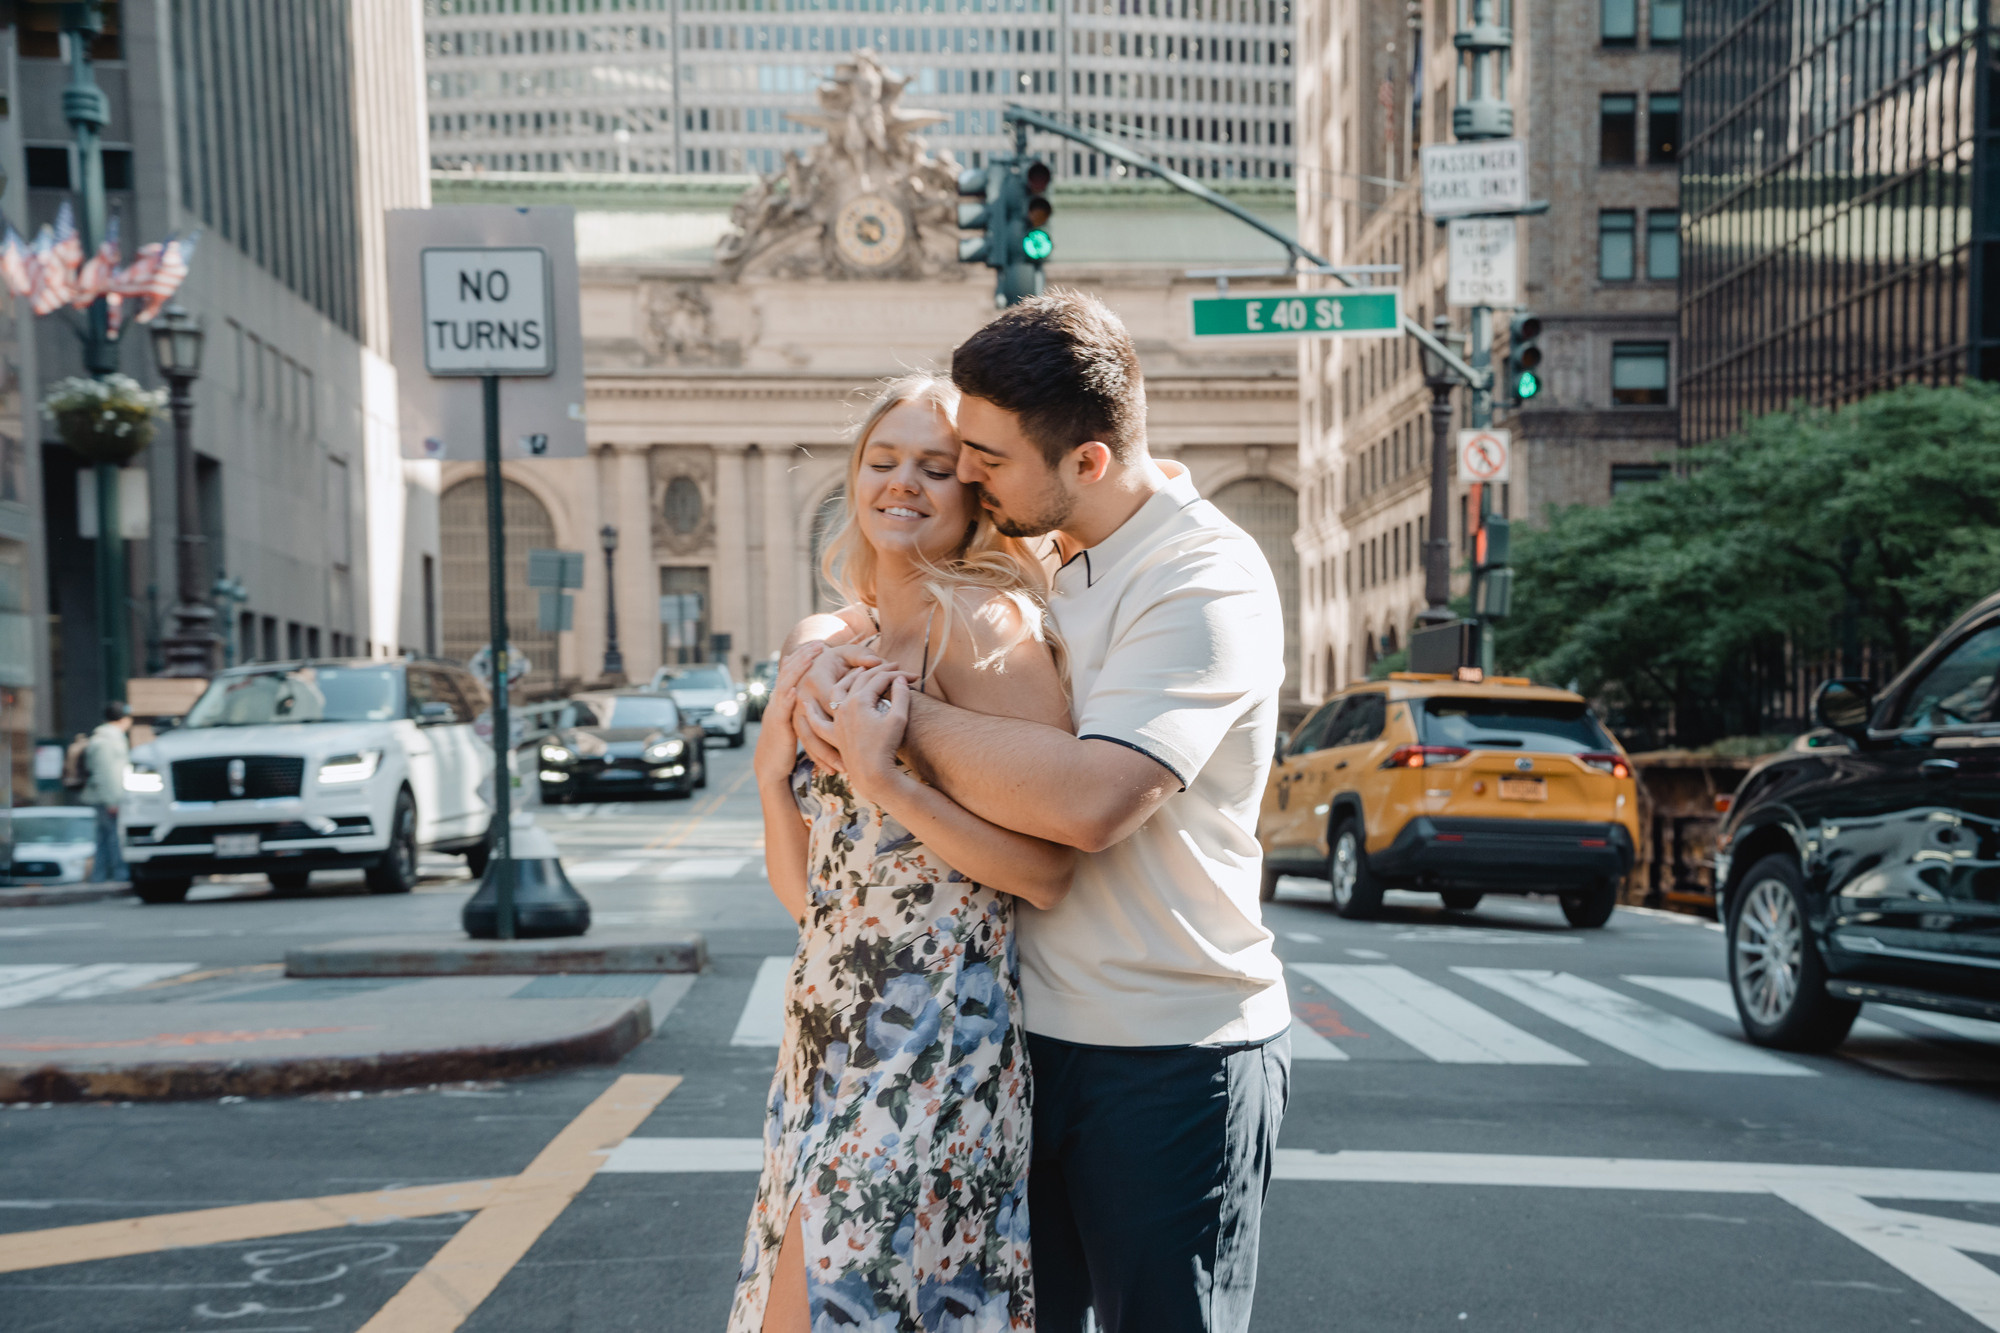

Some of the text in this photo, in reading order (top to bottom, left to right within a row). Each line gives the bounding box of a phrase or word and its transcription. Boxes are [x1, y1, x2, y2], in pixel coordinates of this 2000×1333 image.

[1430, 151, 1516, 174] PASSENGER
[1430, 176, 1517, 200] CARS ONLY
[1471, 257, 1494, 278] 15
[459, 269, 510, 303] NO
[1457, 279, 1507, 297] TONS
[1246, 299, 1344, 331] E 40 St
[432, 320, 542, 351] TURNS
